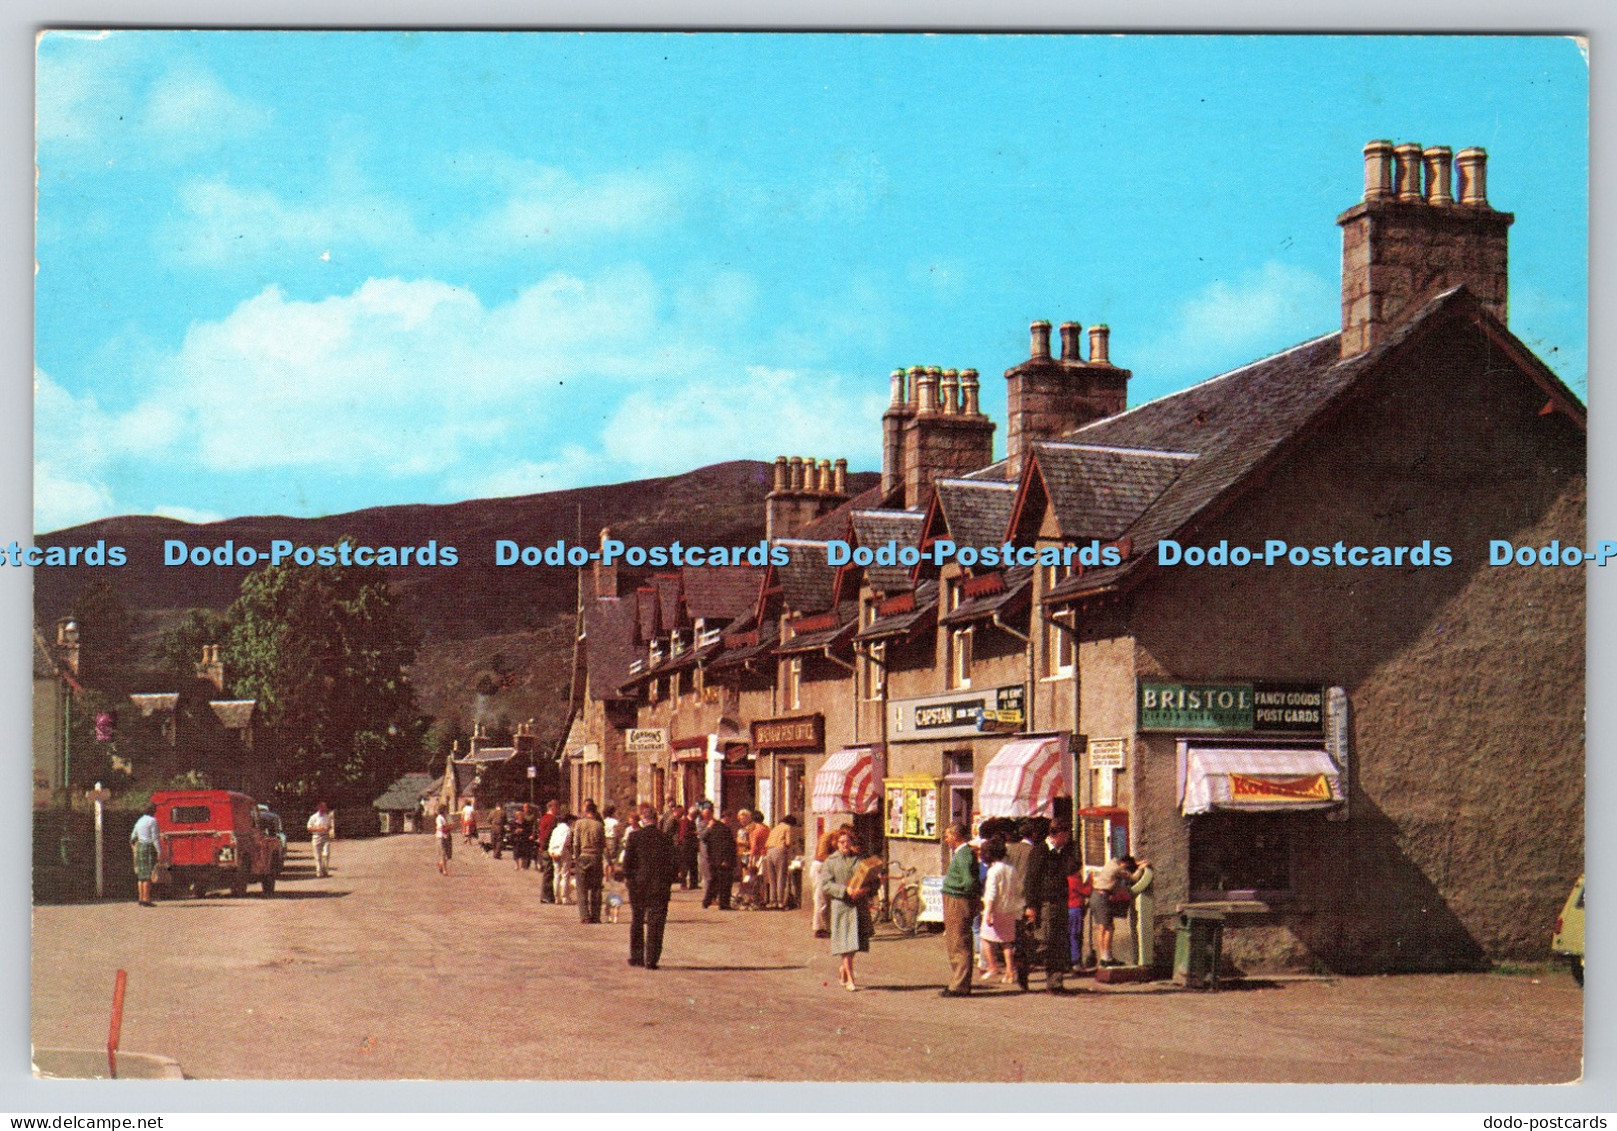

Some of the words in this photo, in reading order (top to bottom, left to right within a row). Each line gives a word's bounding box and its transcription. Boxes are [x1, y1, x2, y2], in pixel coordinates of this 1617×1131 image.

[1143, 689, 1251, 709] BRISTOL
[1254, 692, 1285, 705] FANCY
[1287, 693, 1321, 706] GOODS
[915, 706, 953, 726] CAPSTAN
[1257, 709, 1283, 722] POST
[1284, 709, 1320, 723] CARDS
[628, 743, 665, 751] RESTAURANT
